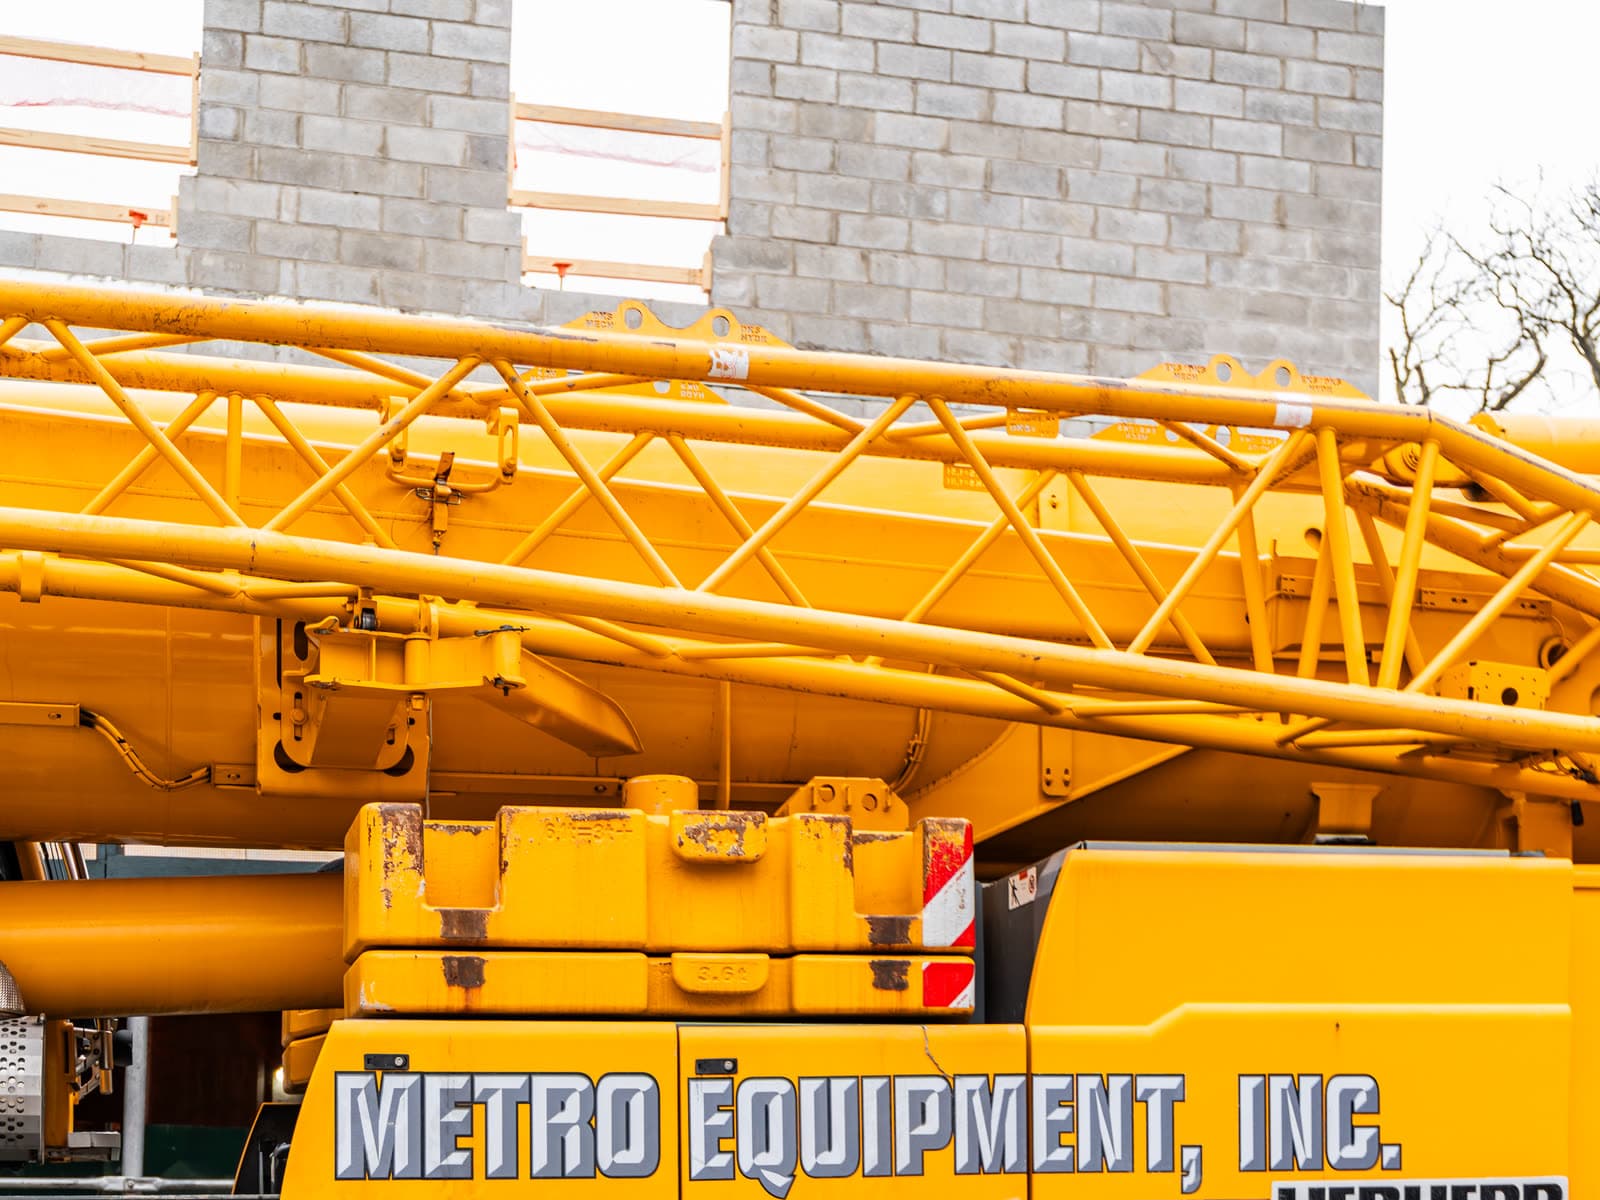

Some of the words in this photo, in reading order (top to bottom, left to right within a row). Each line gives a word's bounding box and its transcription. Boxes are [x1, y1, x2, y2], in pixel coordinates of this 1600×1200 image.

[335, 1072, 661, 1180] METRO
[688, 1073, 1202, 1200] EQUIPMENT,
[1238, 1073, 1401, 1172] INC.
